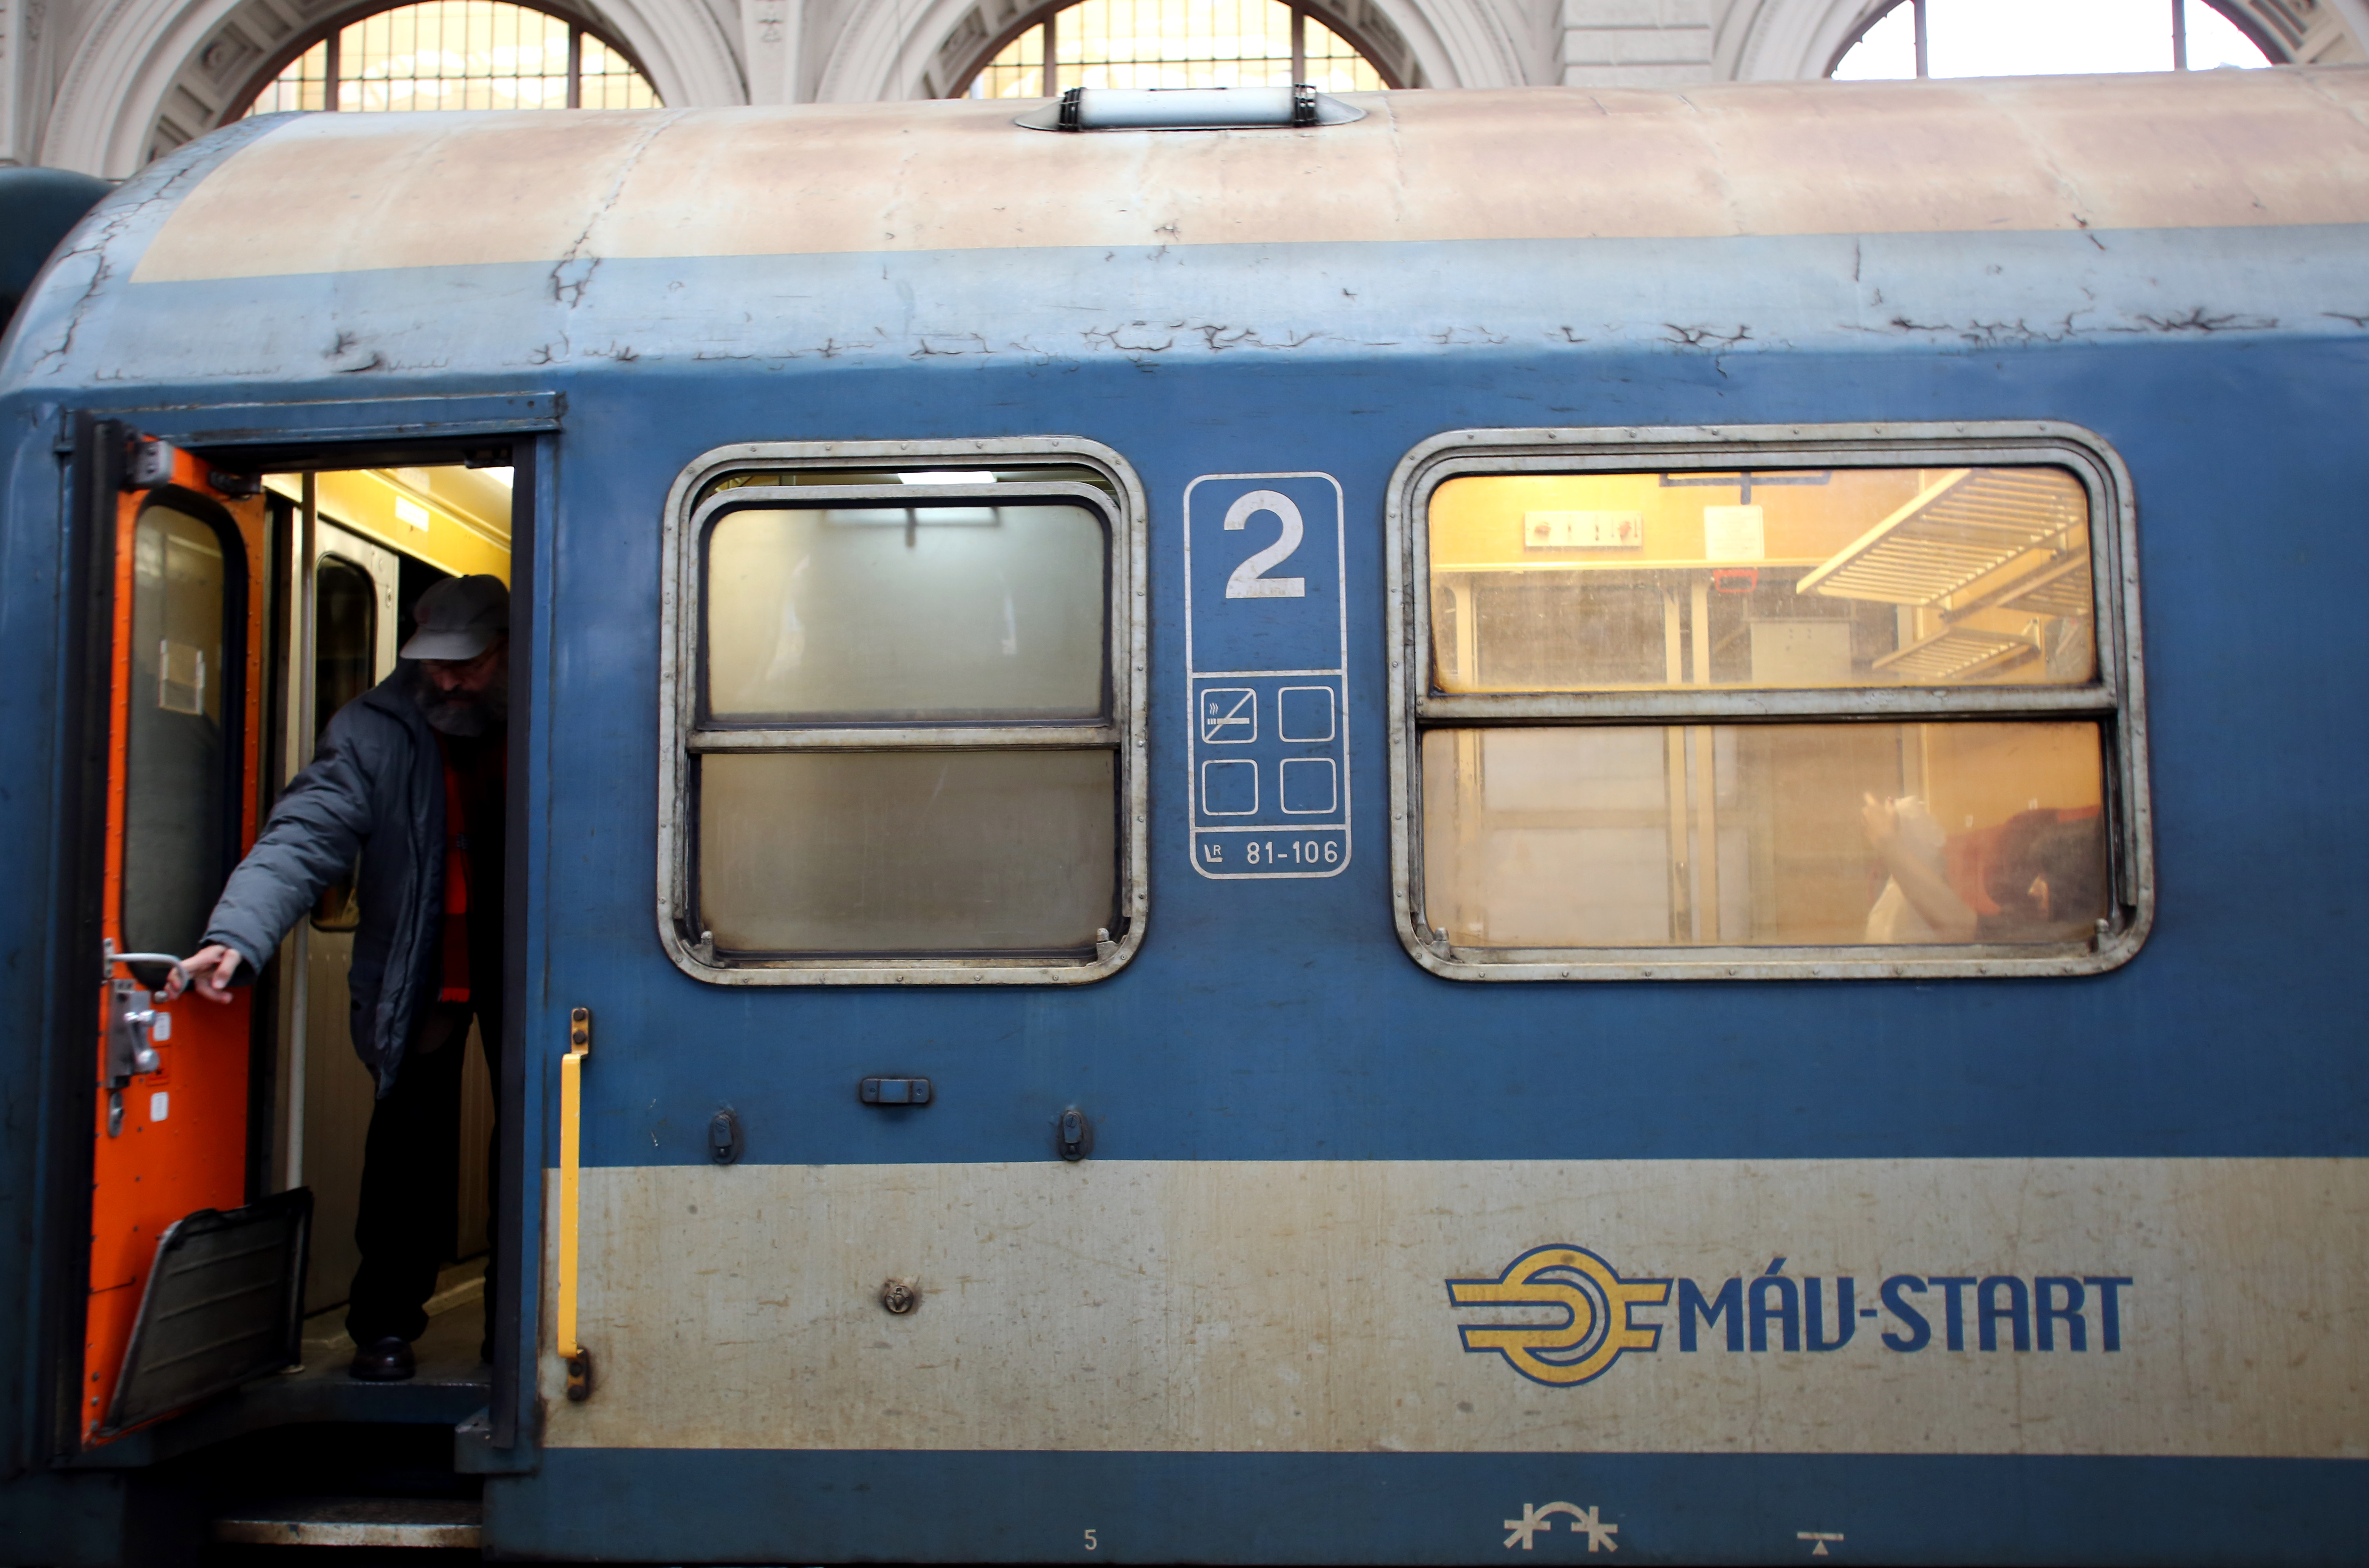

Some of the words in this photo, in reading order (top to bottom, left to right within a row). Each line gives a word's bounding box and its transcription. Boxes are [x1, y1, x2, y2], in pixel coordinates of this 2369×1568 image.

[1224, 490, 1306, 599] 2
[1247, 840, 1338, 864] 81-106
[1084, 1529, 1098, 1551] 5
